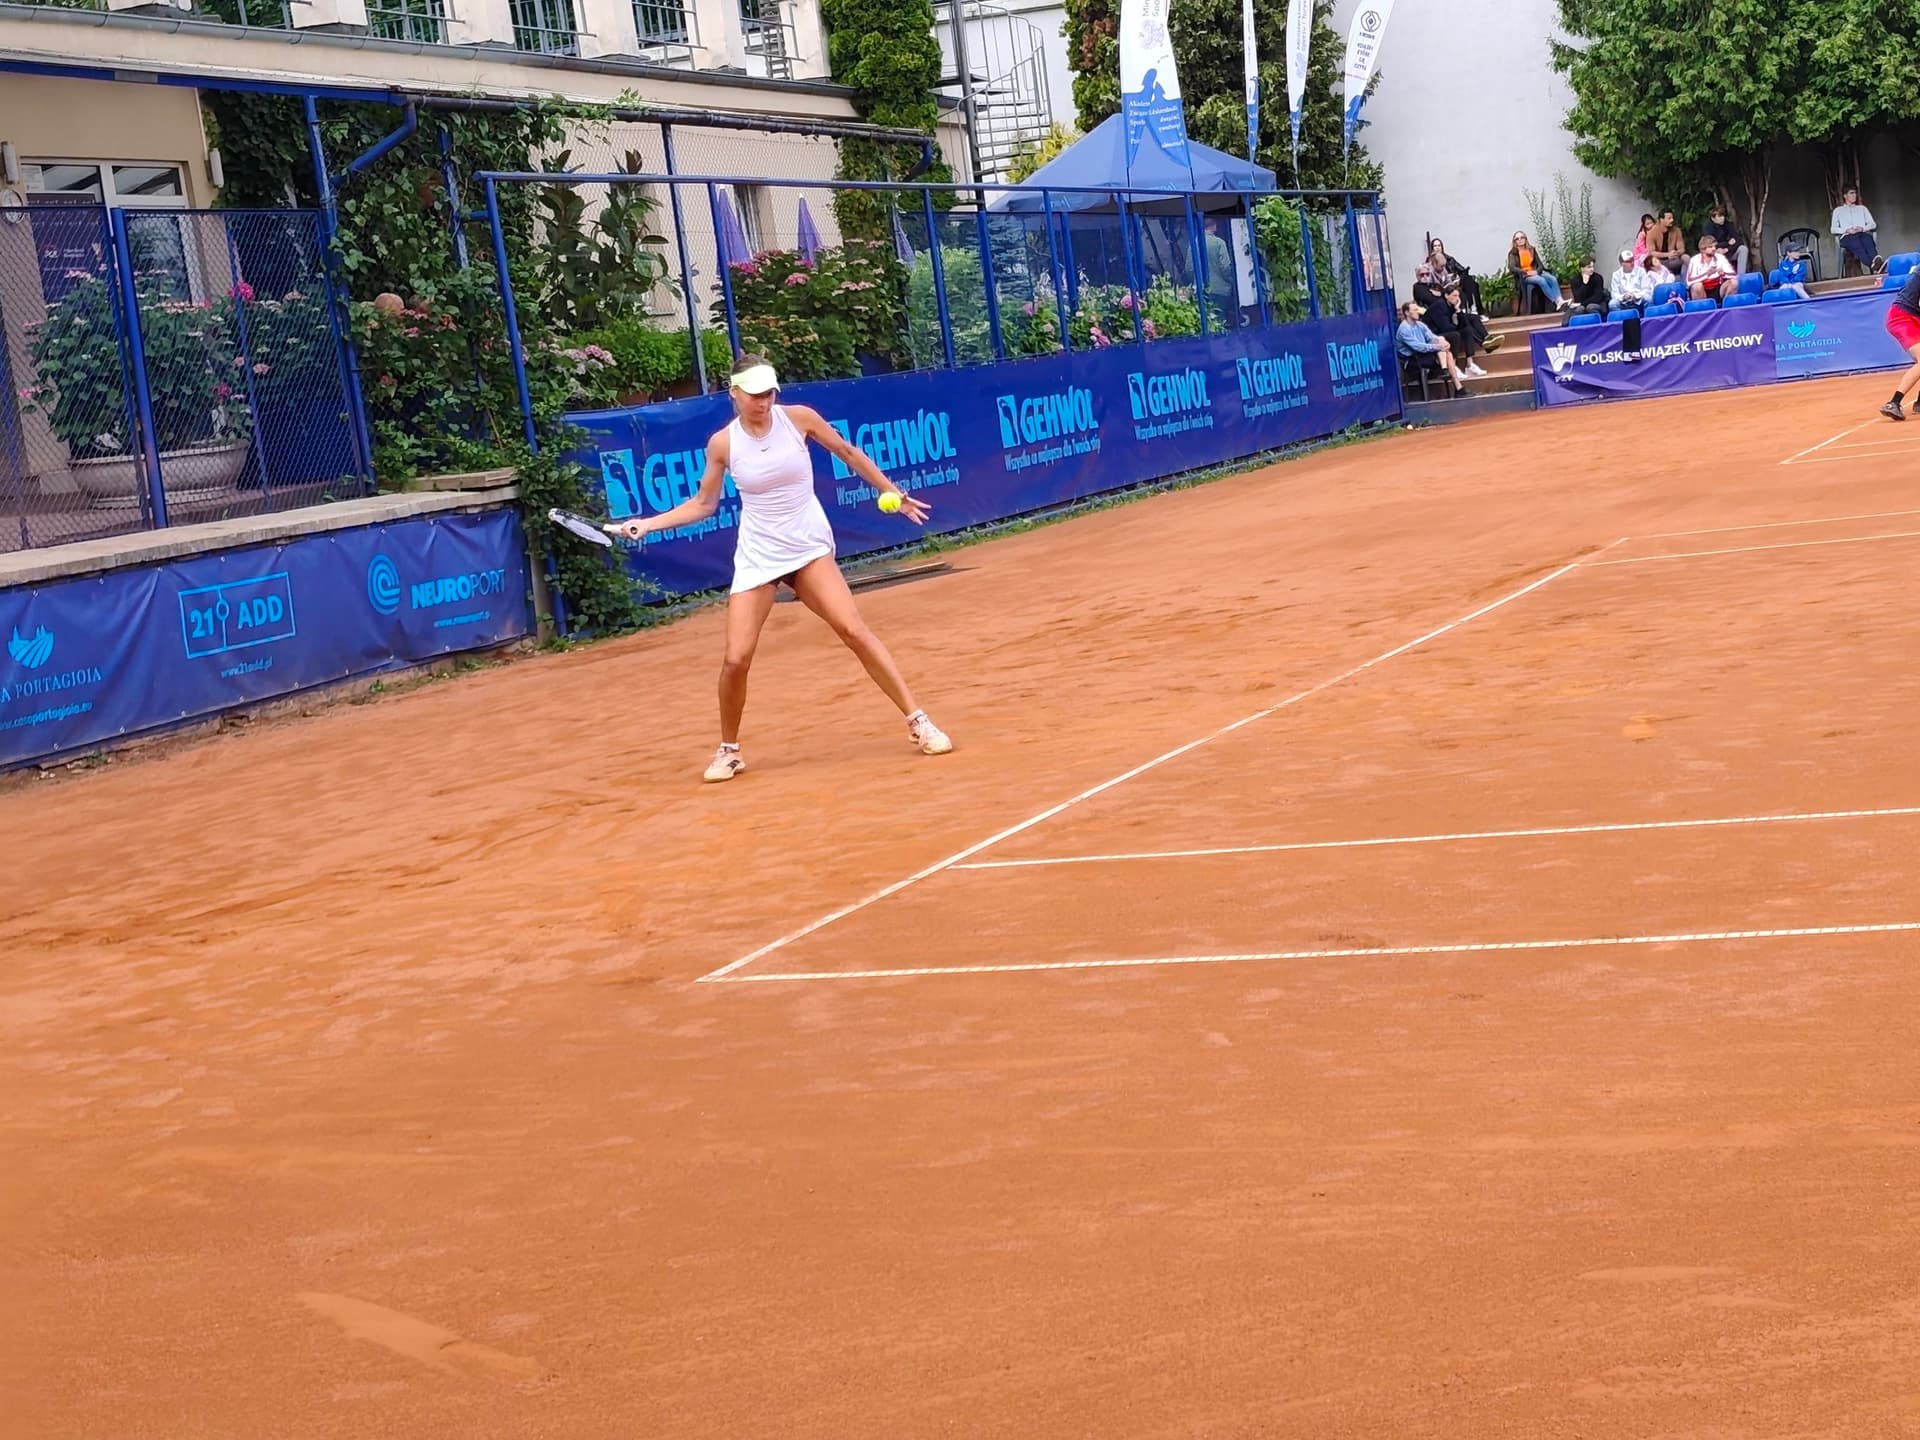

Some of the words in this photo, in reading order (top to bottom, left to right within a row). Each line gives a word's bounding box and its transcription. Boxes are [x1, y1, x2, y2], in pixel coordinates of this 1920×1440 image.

[1580, 350, 1624, 366] POLSK
[1640, 342, 1691, 360] WIĄZEK
[1694, 333, 1763, 352] TENISOWY
[1147, 366, 1211, 417] GEHWOL
[1253, 351, 1307, 397] GEHWOL
[1020, 384, 1099, 443] GEHWOL
[856, 408, 957, 471] GEHWOL
[411, 568, 505, 609] NEUROPORT
[190, 607, 215, 638] 21
[237, 595, 283, 629] ADD
[16, 666, 102, 700] PORTAGIOIA
